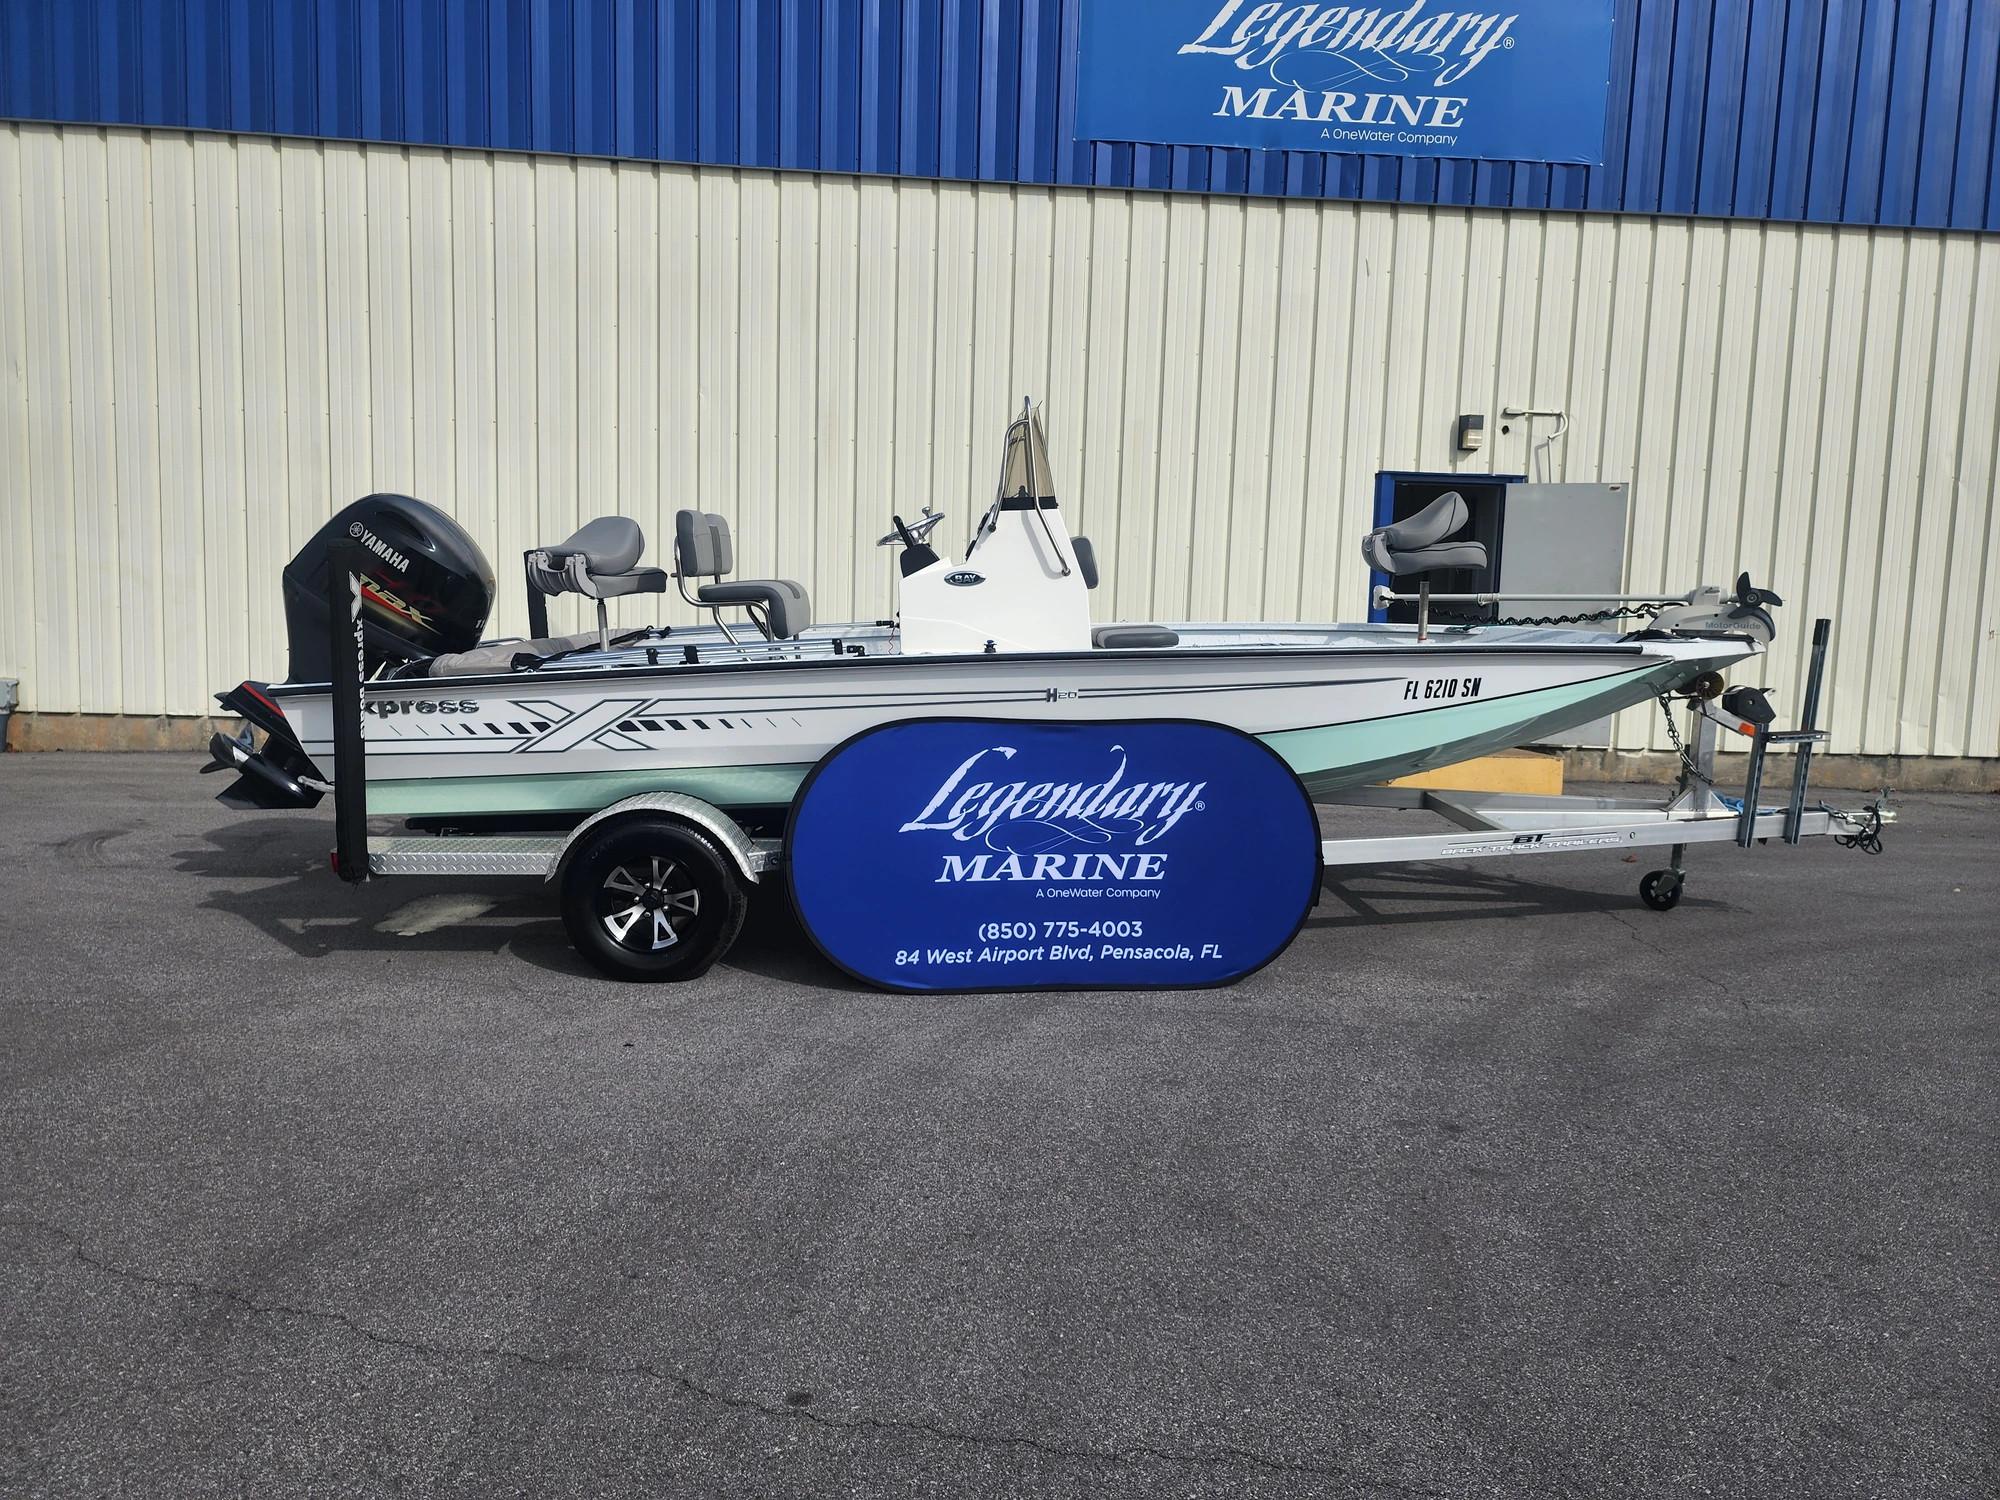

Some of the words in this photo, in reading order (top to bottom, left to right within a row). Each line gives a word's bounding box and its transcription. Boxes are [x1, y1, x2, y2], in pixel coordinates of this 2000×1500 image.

[1213, 86, 1469, 127] MARINE
[1320, 128, 1330, 139] A
[1333, 128, 1394, 141] OneWater
[1398, 131, 1458, 146] Company
[360, 529, 410, 573] YAMAHA
[1404, 681, 1419, 700] FL
[1424, 679, 1458, 699] 6210
[1461, 677, 1482, 697] SN
[935, 853, 1168, 883] MARINE
[1036, 888, 1044, 898] A
[1047, 887, 1103, 898] OneWater
[1106, 887, 1160, 899] Company
[978, 922, 1036, 942] (850)
[1043, 921, 1143, 938] 775-4003
[895, 950, 919, 965] 84
[927, 948, 973, 964] West
[977, 946, 1044, 964] Airport
[1049, 944, 1094, 961] Blvd,
[1100, 944, 1194, 961] Pensacola,
[1200, 944, 1222, 959] FL
